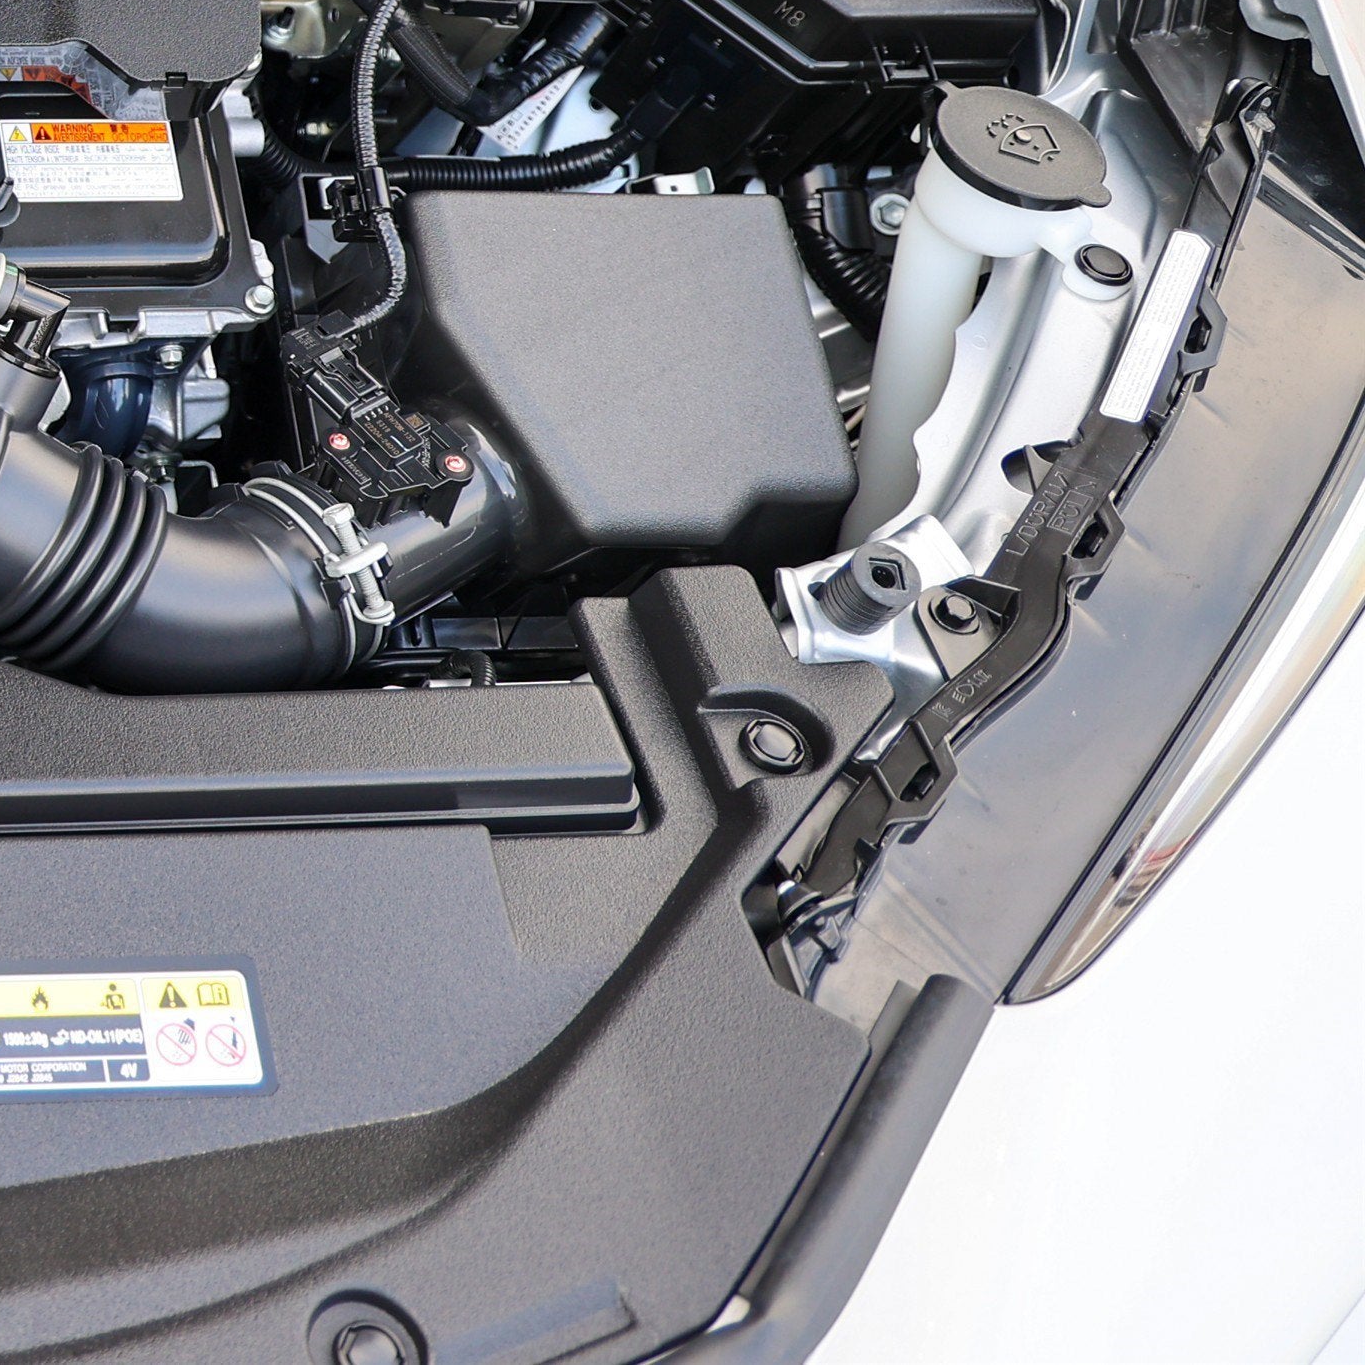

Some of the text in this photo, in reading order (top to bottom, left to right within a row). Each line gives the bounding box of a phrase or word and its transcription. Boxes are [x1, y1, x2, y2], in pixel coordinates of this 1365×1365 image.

[773, 0, 806, 26] M8
[51, 123, 94, 133] WARNING
[0, 1063, 29, 1073] MOTOR
[30, 1061, 87, 1073] CORPORATION
